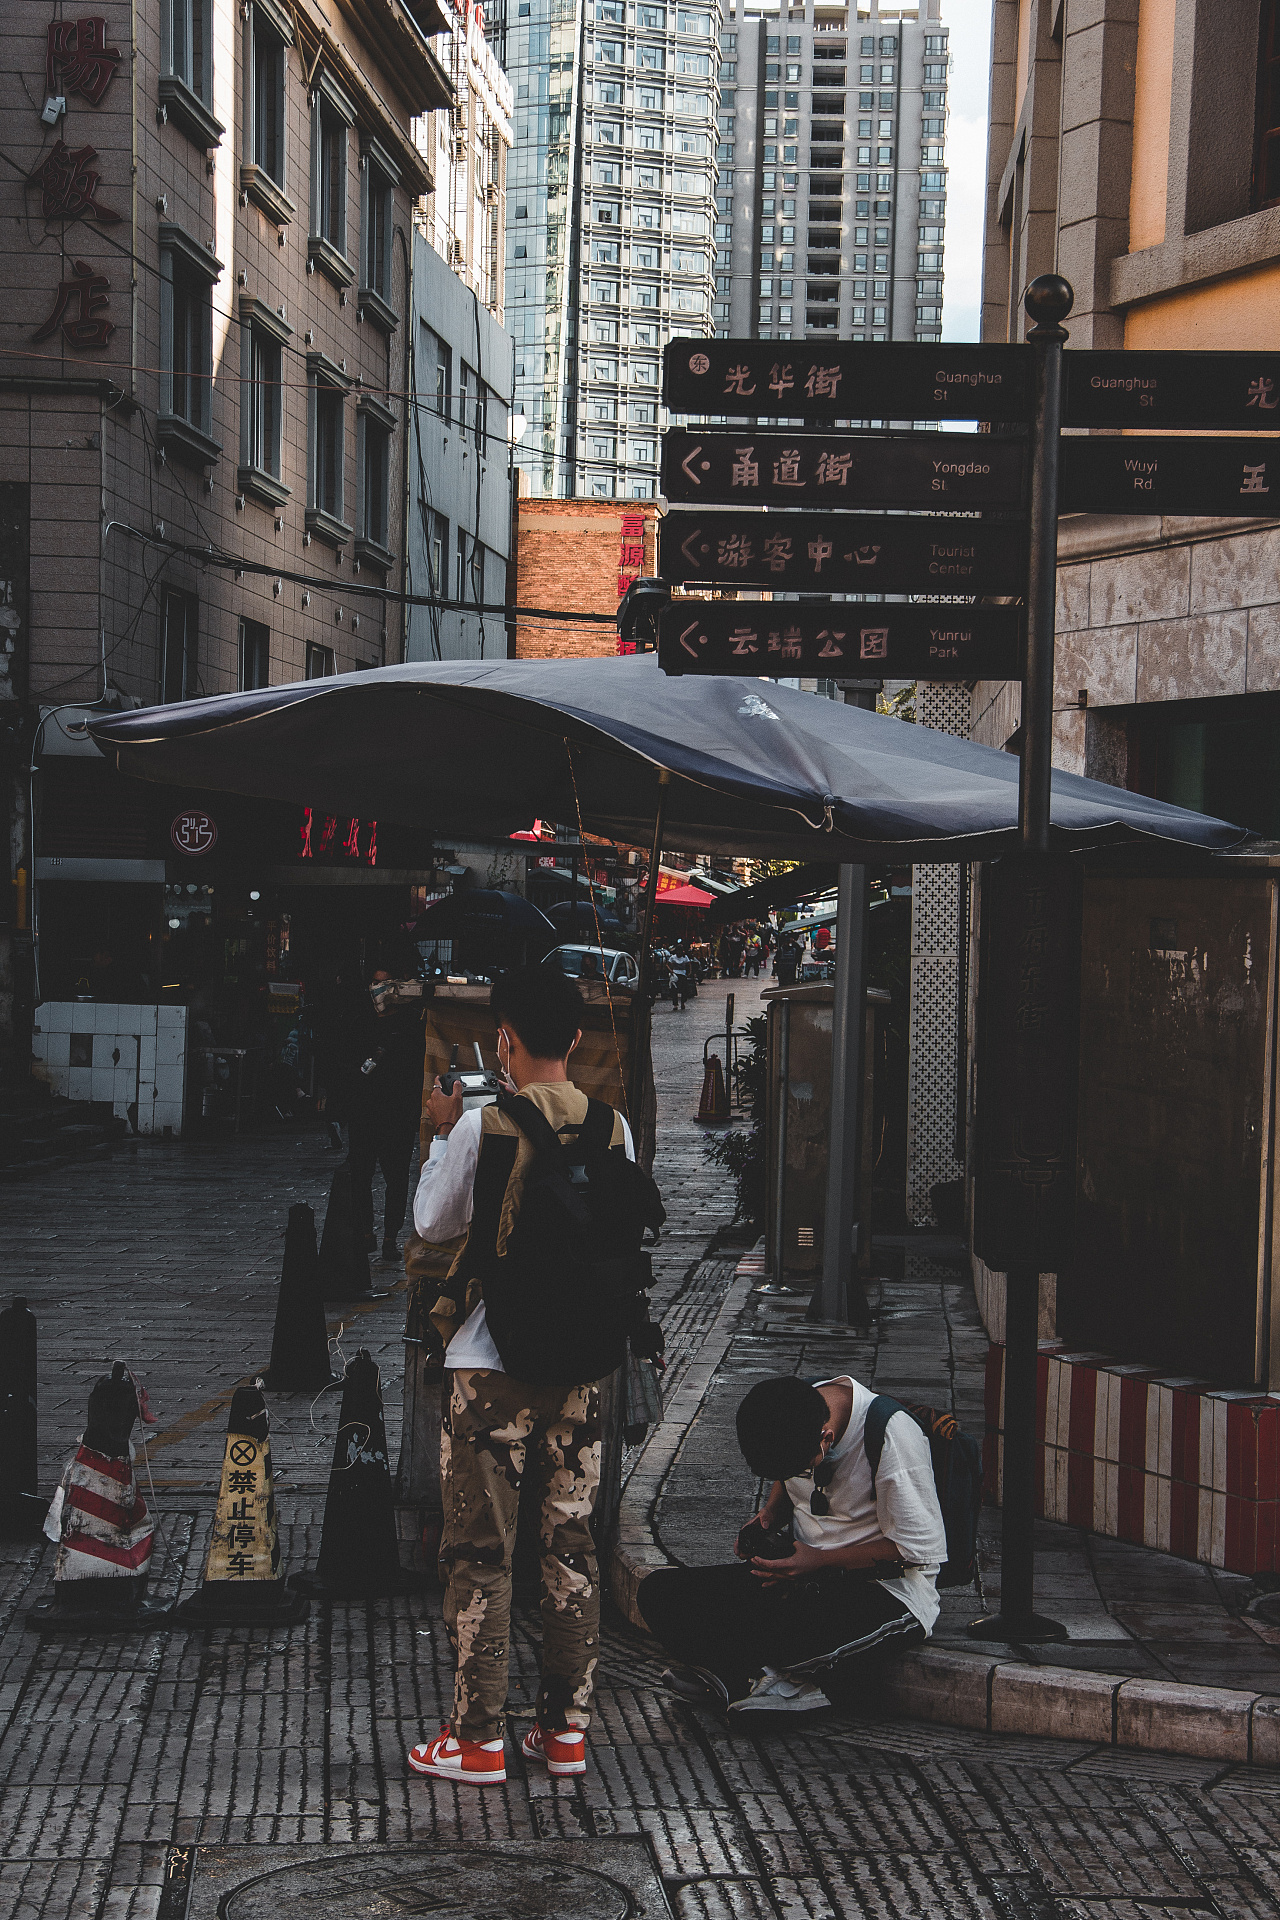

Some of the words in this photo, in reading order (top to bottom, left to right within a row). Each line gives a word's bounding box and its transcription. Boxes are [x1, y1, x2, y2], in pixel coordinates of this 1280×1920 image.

[32, 17, 122, 348] 陽飯店
[724, 363, 842, 399] 光华街
[935, 370, 1002, 387] Guanghua
[1090, 376, 1158, 391] Guanghua
[1246, 376, 1280, 409] 光
[731, 446, 853, 488] 甬道街
[932, 461, 991, 476] Yongdao
[1124, 459, 1158, 475] Wuyi
[1239, 462, 1270, 494] 五
[717, 533, 881, 573] 游客中心
[929, 544, 976, 558] Tourist
[928, 561, 974, 575] Center
[728, 627, 889, 661] 云瑞公园
[929, 629, 972, 641] Yunrui
[929, 646, 959, 658] Park
[226, 1470, 257, 1576] 禁止停车
